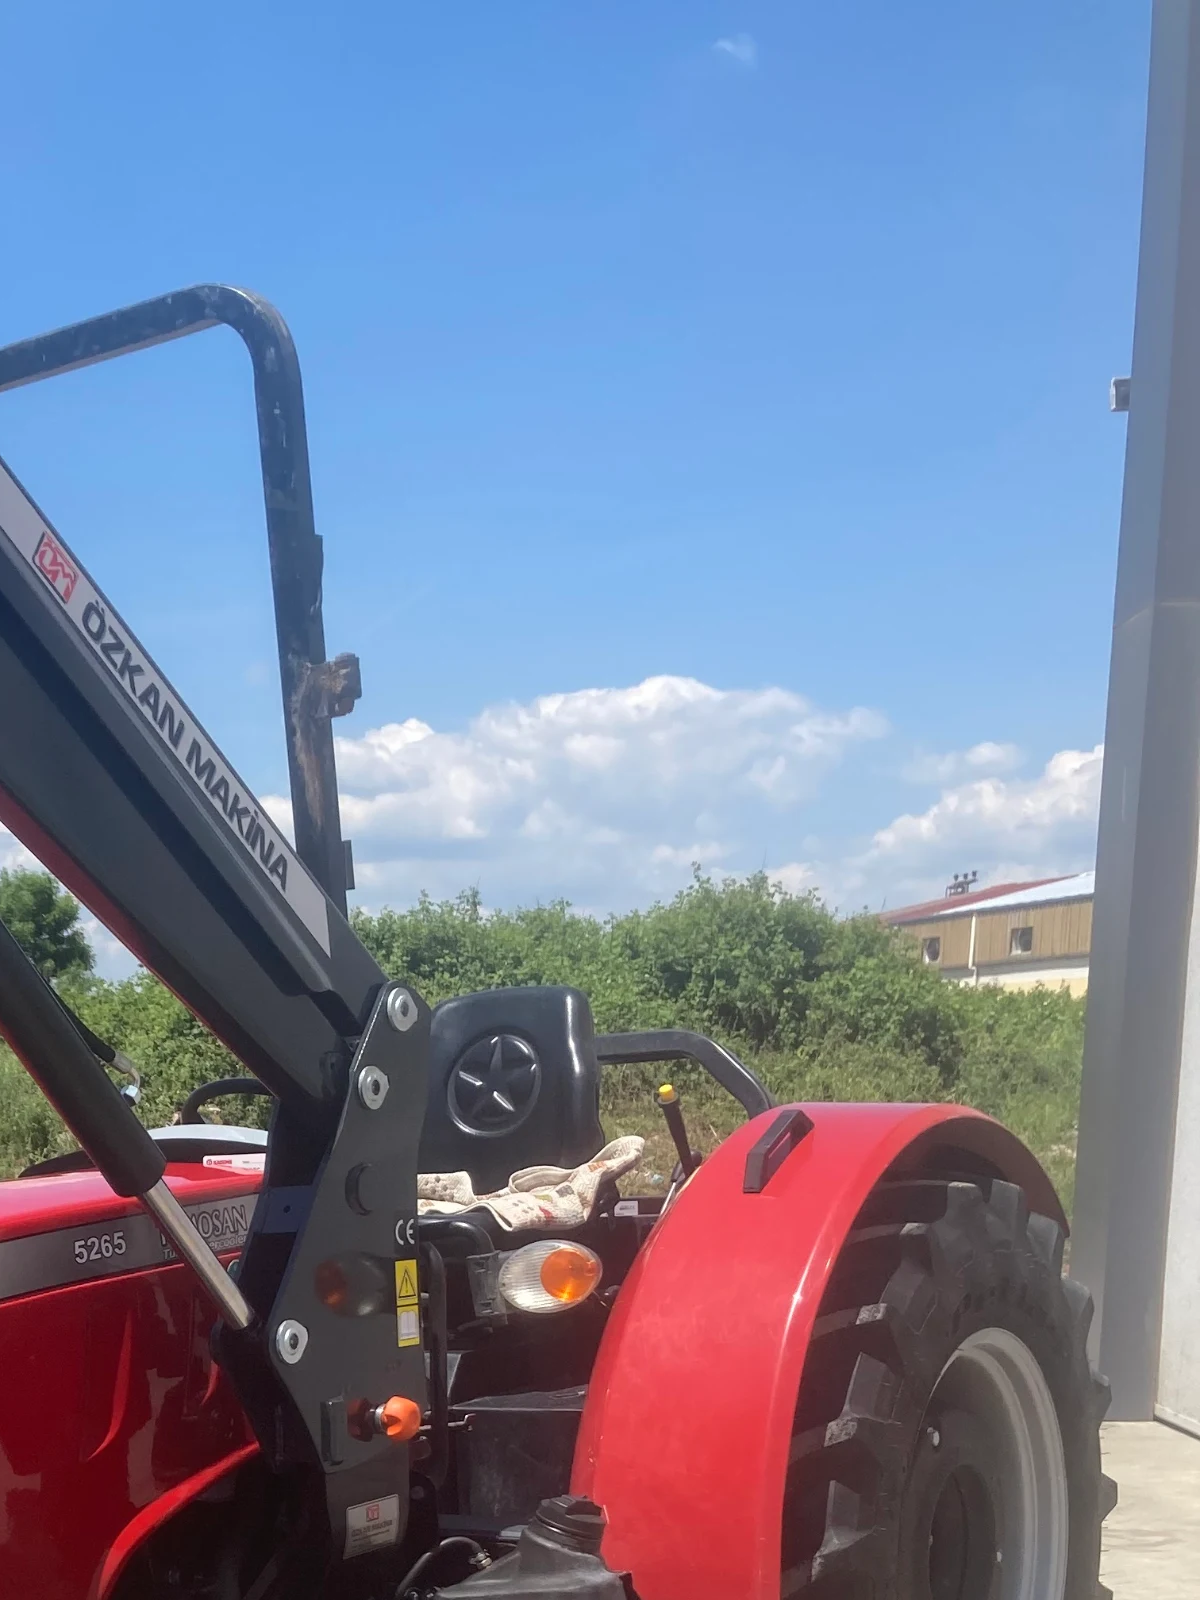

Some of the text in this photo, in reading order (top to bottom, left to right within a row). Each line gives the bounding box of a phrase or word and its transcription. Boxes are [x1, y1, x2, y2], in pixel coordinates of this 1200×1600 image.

[81, 599, 289, 892] ÖZKAN MAKİNA
[73, 1230, 127, 1264] 5265
